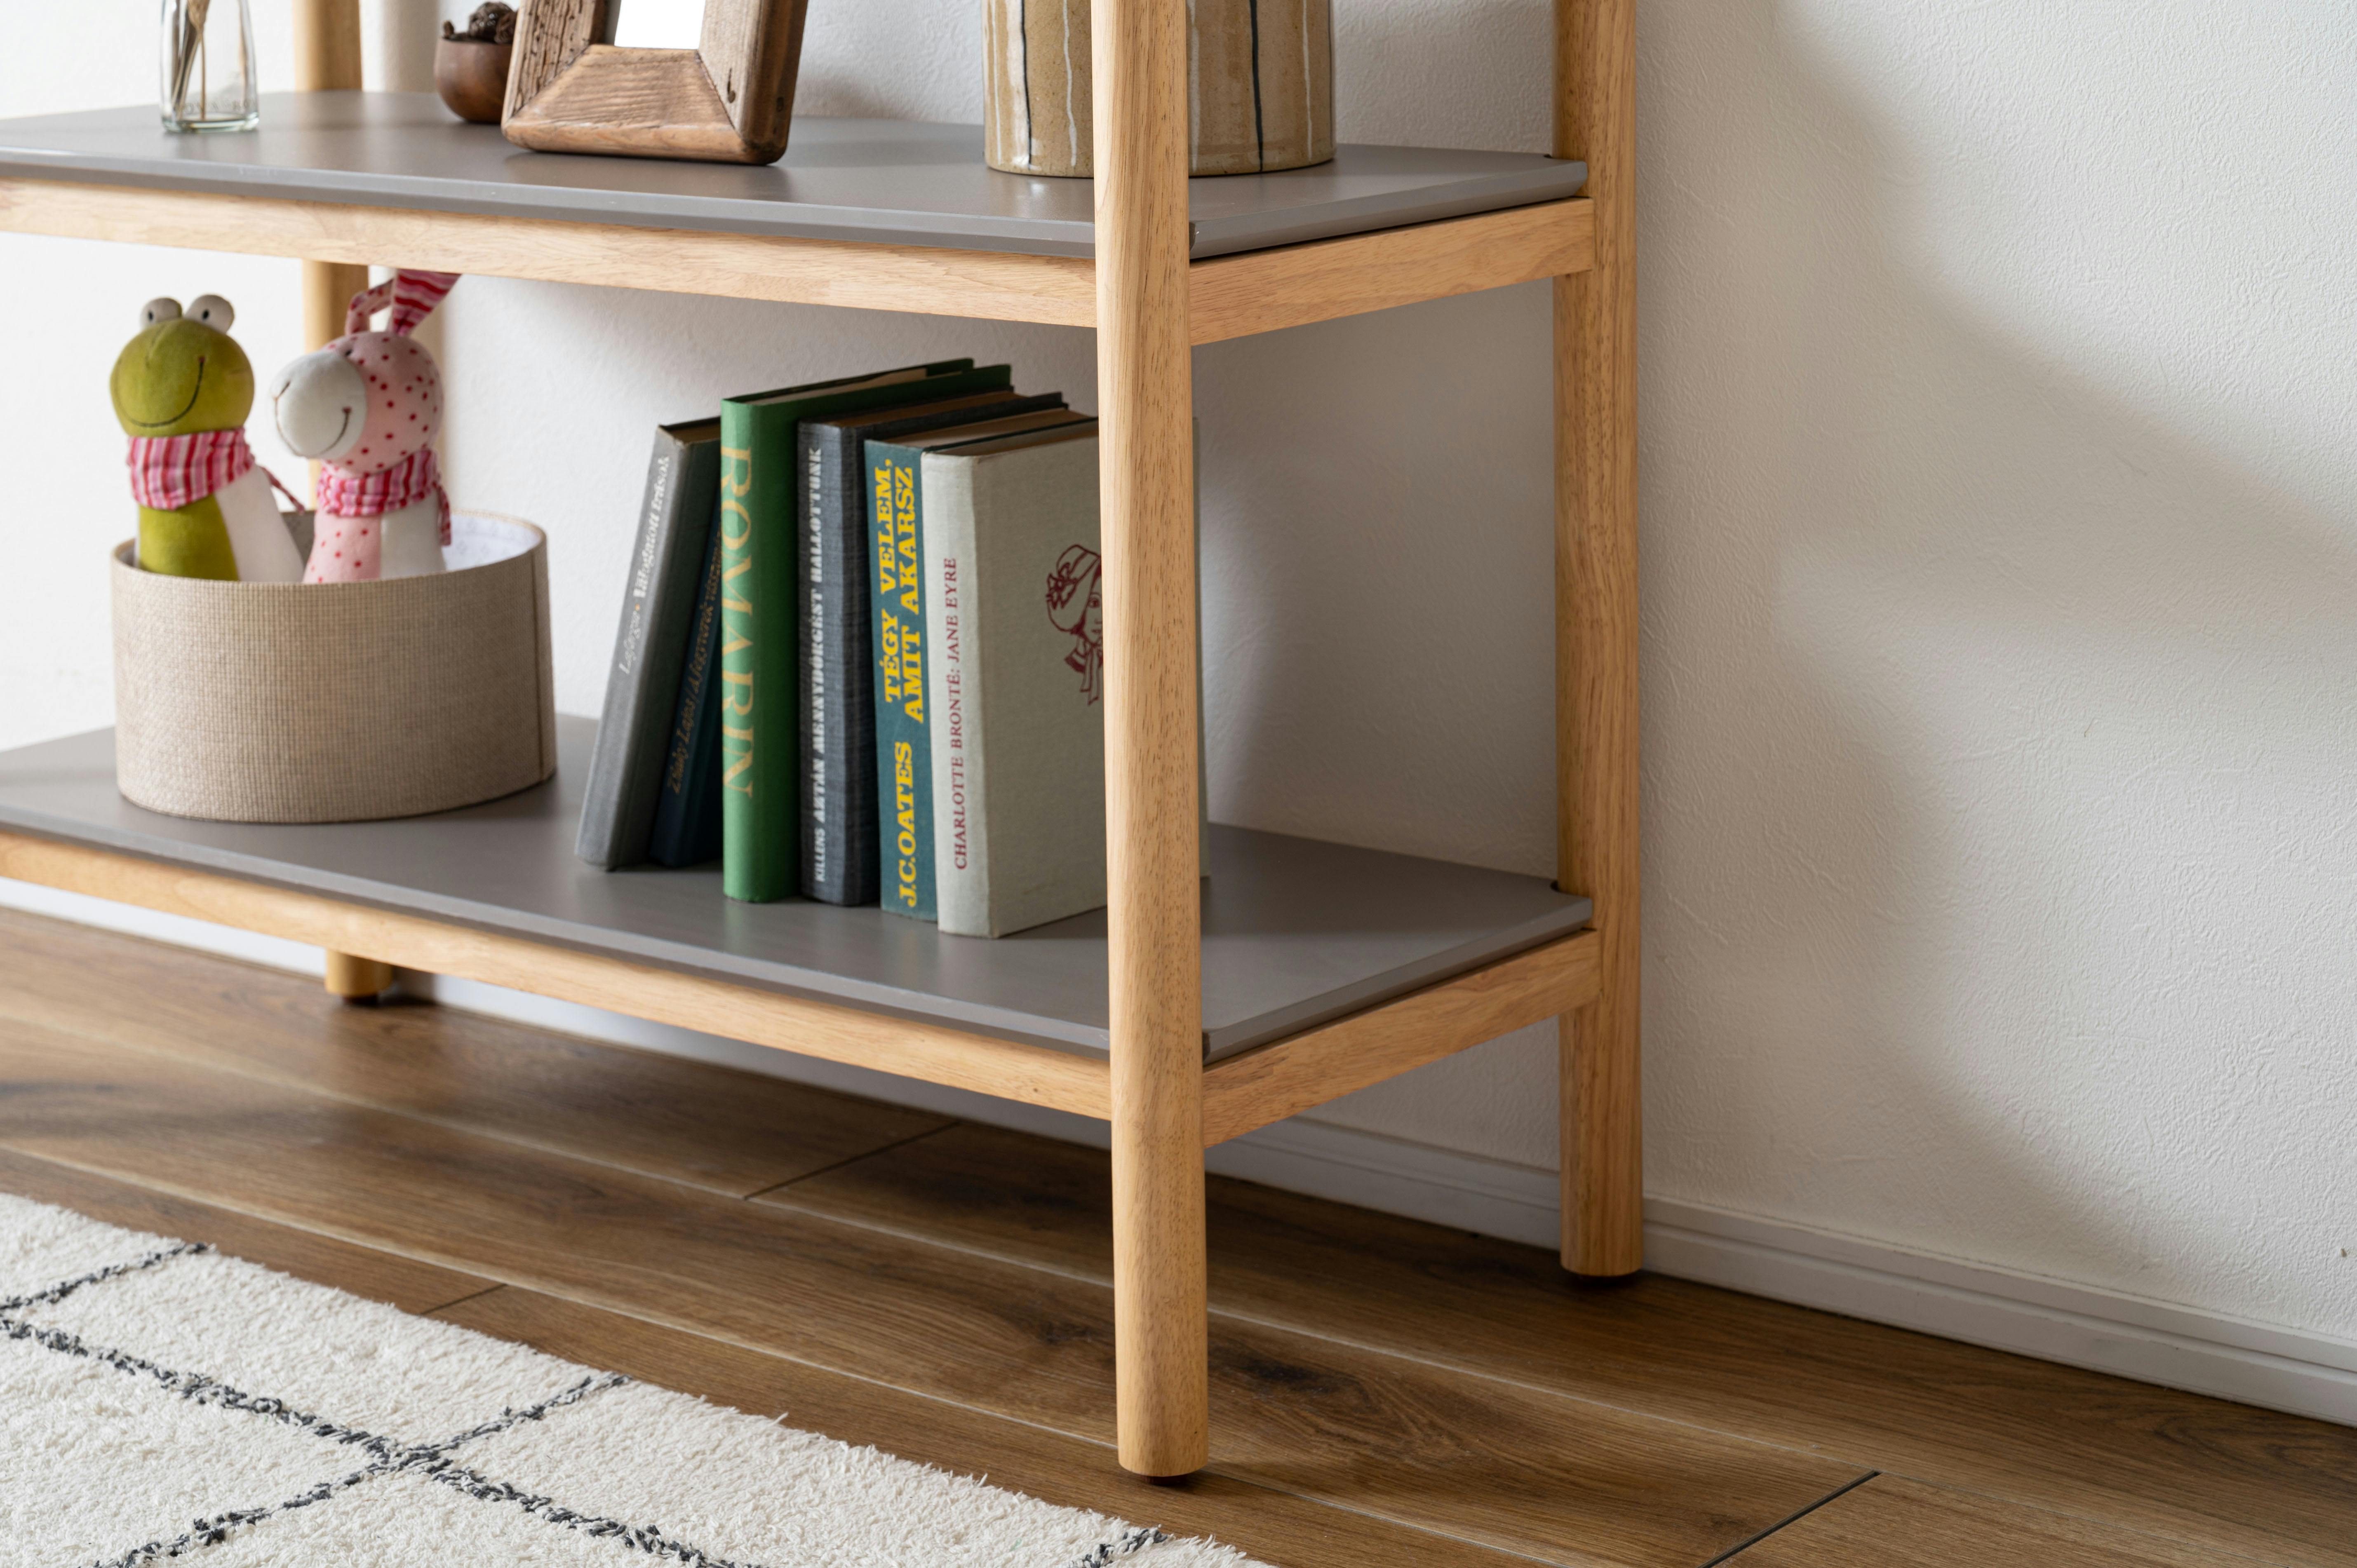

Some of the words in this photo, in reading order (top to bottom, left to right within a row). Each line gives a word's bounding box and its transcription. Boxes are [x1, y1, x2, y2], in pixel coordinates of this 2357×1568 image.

[809, 448, 823, 584] HALLOTTUNK
[874, 459, 895, 594] VELEM,
[895, 467, 919, 615] AKARSZ
[721, 446, 754, 798] ROMARIN
[943, 558, 957, 609] EYRE
[879, 609, 900, 702] TÉGY
[901, 625, 923, 723] AMIT
[946, 615, 960, 663] JANE
[677, 698, 696, 744] Lajos
[946, 667, 962, 749] BRONTË:
[814, 828, 825, 882] KILLENS
[951, 756, 968, 870] CHARLOTTE
